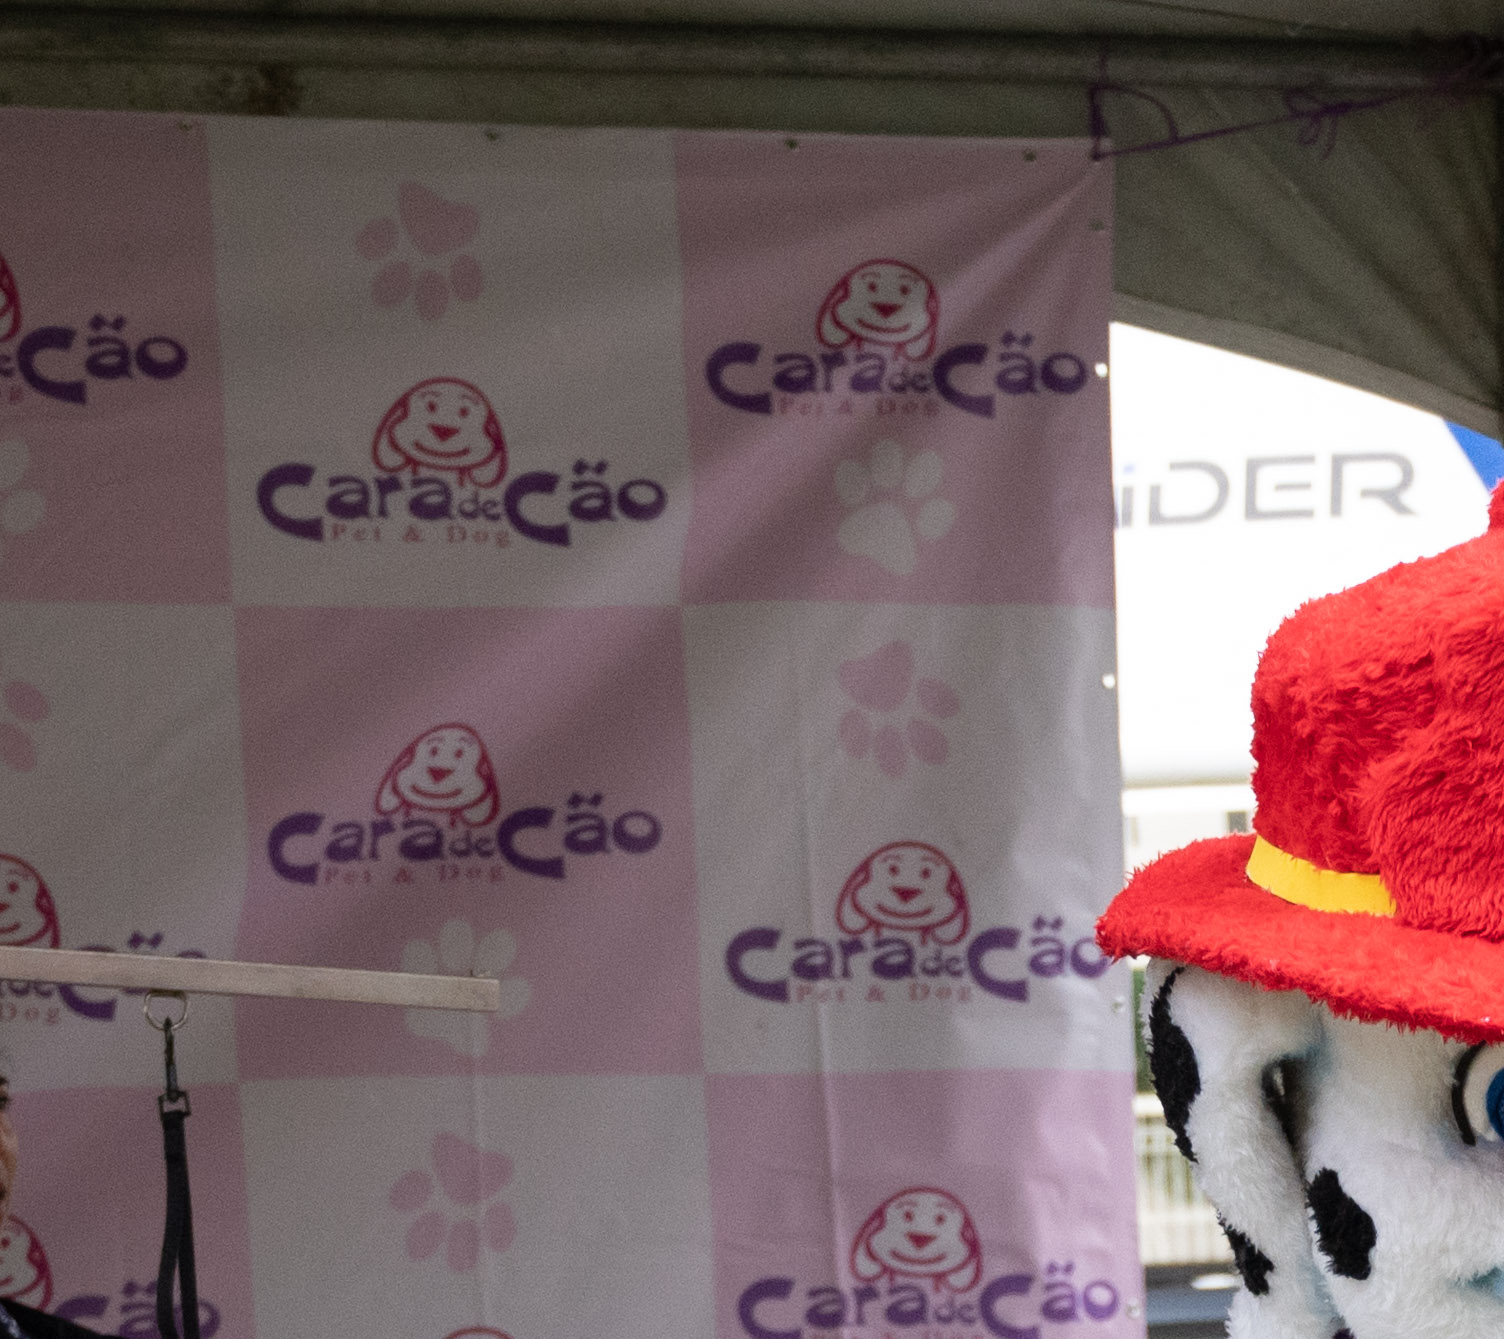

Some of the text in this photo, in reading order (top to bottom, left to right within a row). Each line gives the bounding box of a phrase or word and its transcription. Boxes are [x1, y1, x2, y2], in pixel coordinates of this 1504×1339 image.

[705, 340, 886, 415] Cara
[890, 363, 933, 394] de
[256, 463, 454, 542] Cara
[457, 489, 503, 522] de
[330, 523, 383, 544] Pet
[445, 525, 512, 550] Dog
[266, 810, 449, 886] Cara
[451, 827, 497, 858] de
[724, 927, 916, 1004] Cara
[919, 947, 964, 979] de
[931, 1293, 975, 1324] de
